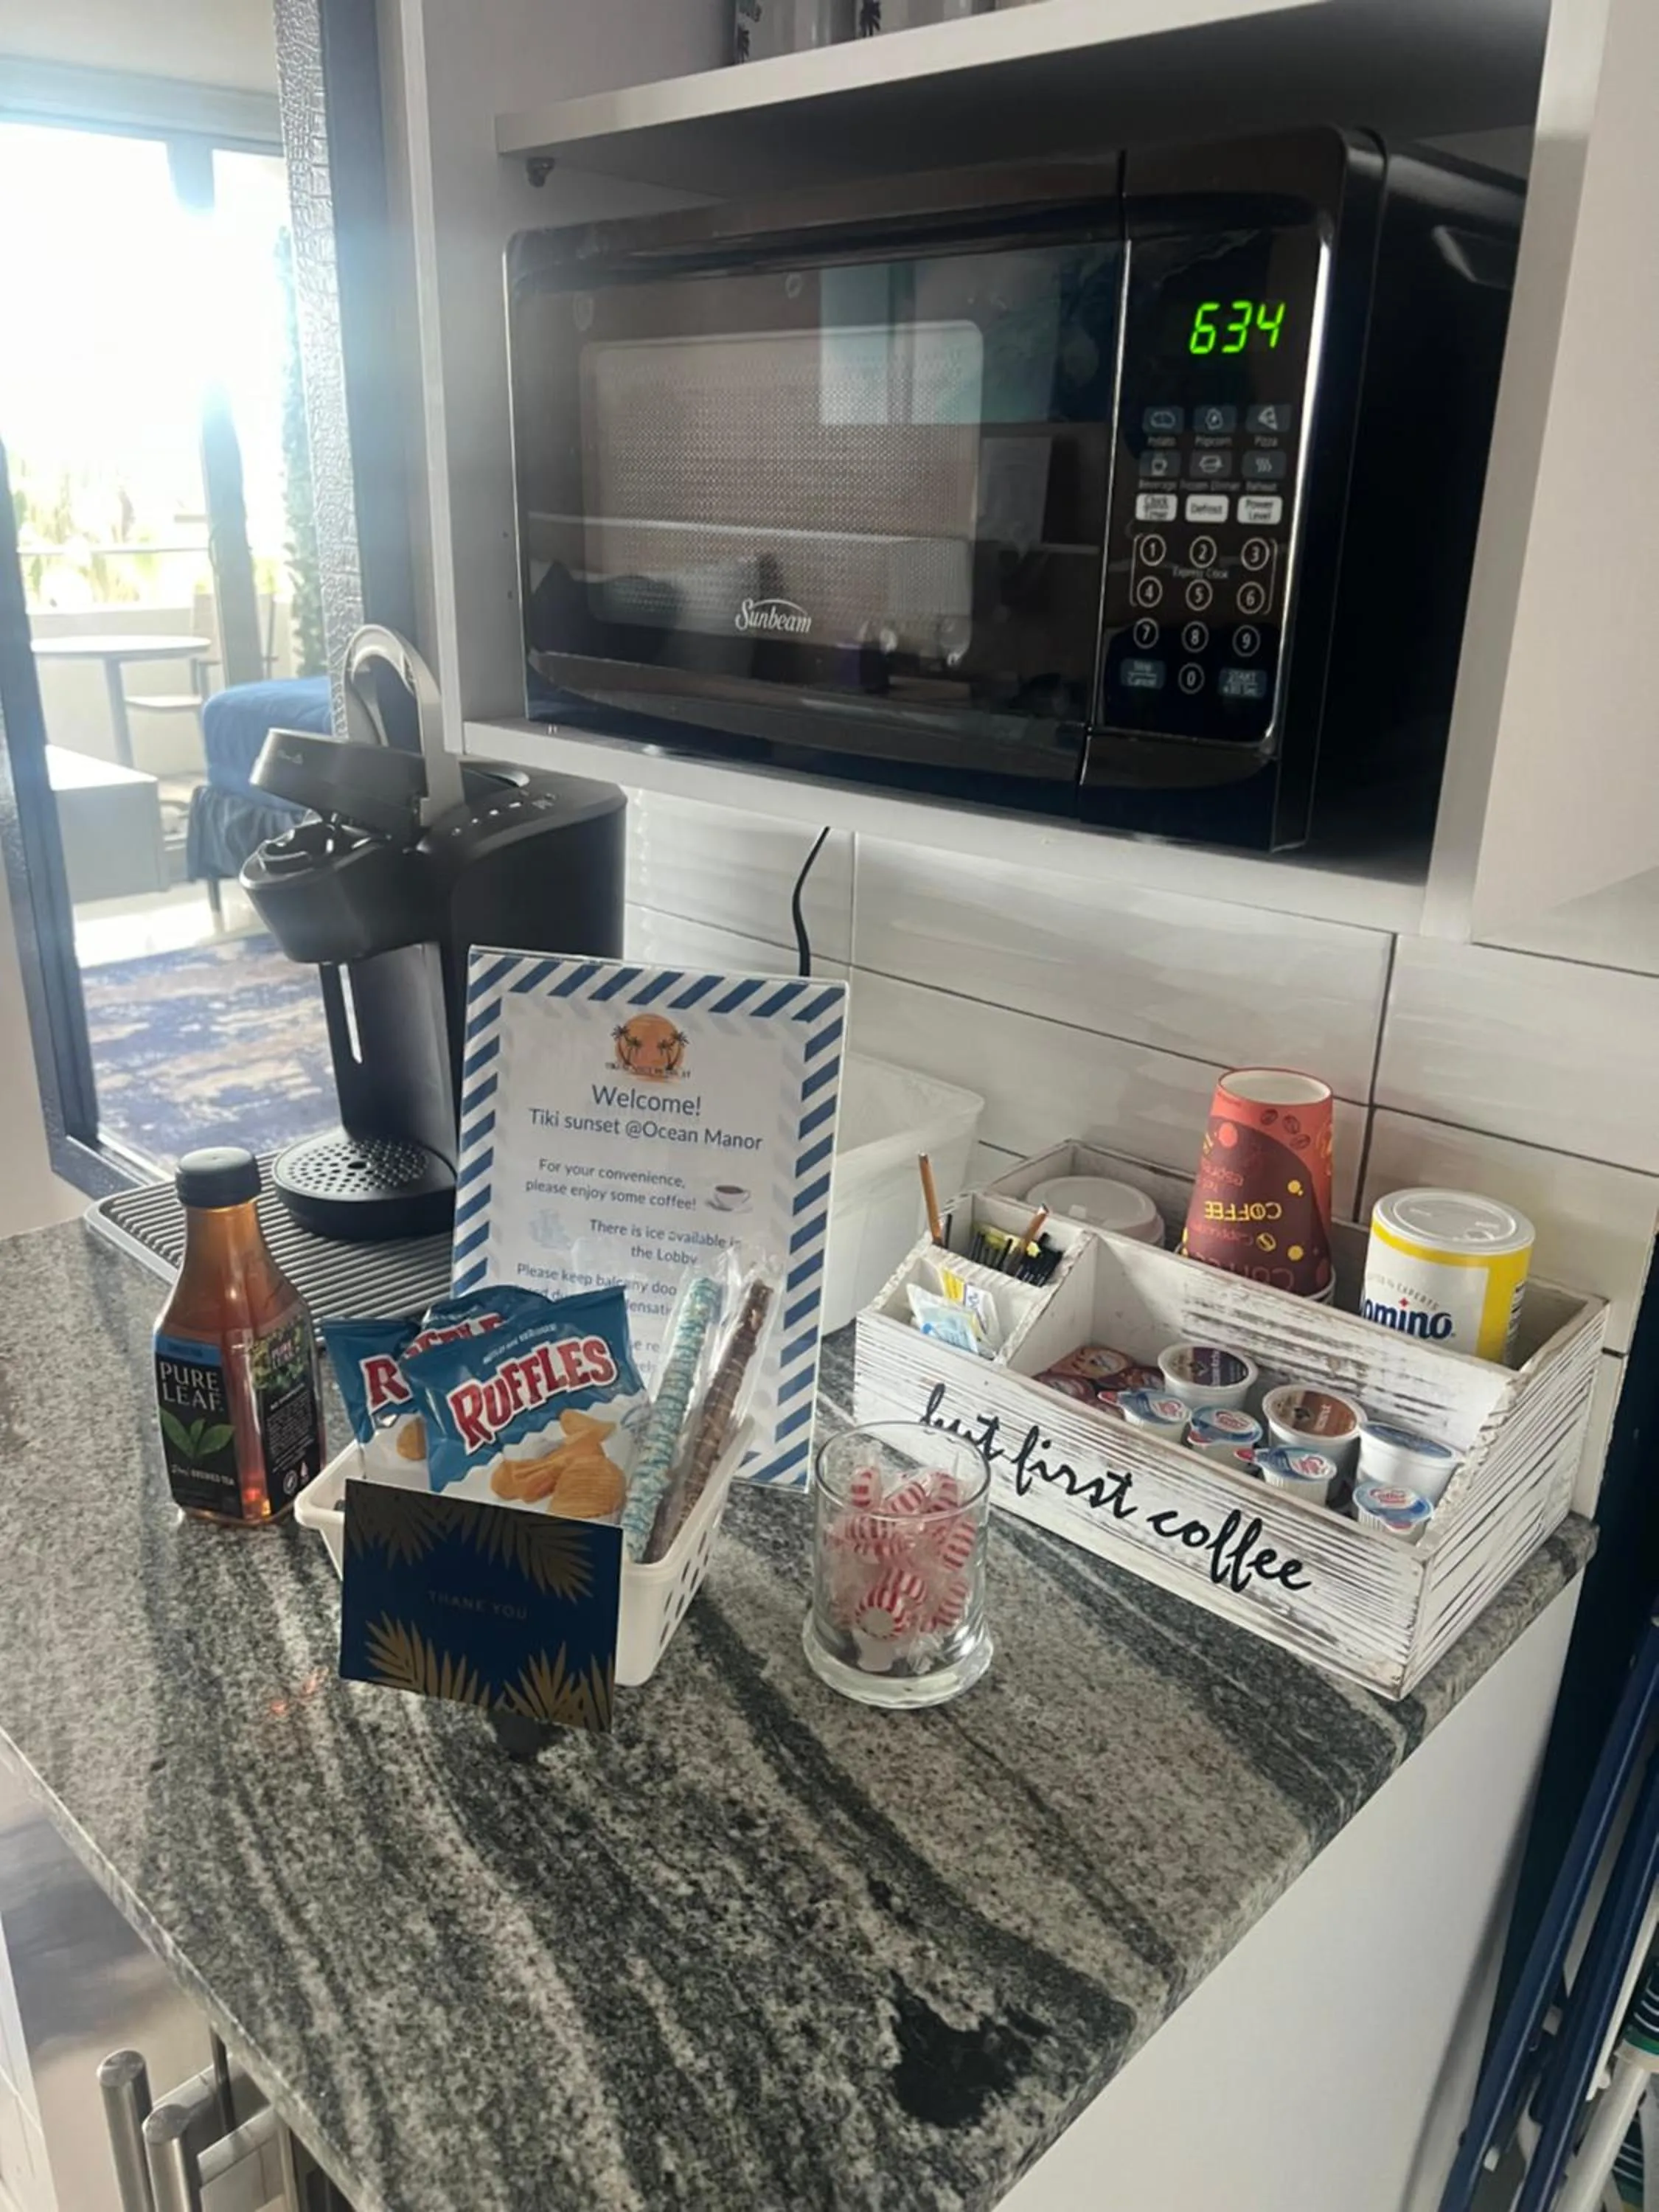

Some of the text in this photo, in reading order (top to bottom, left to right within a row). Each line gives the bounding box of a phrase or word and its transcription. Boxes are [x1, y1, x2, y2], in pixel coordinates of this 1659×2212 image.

[1189, 300, 1286, 355] 634
[1149, 542, 1157, 558] 1
[1198, 543, 1208, 561] 2
[1251, 546, 1260, 564] 3
[1144, 584, 1154, 600] 4
[1194, 586, 1203, 604] 5
[1246, 590, 1255, 607] 6
[735, 598, 812, 633] Sunbeam
[1143, 625, 1151, 642] 7
[1191, 629, 1200, 646] 8
[1242, 632, 1251, 650] 9
[1186, 670, 1196, 686] 0
[591, 1084, 701, 1117] Welcome!
[529, 1107, 763, 1150] Tiki sunset @Ocean Manor
[539, 1158, 562, 1172] For
[565, 1163, 595, 1177] your
[526, 1179, 697, 1211] please enjoy some coffee!
[1203, 1200, 1283, 1222] COFFEE
[590, 1218, 627, 1237] There
[630, 1223, 642, 1238] is
[645, 1225, 665, 1241] ice
[667, 1231, 728, 1249] available
[631, 1245, 699, 1266] the Lobby
[517, 1262, 560, 1281] Please
[561, 1268, 593, 1287] keep
[651, 1281, 678, 1297] doo
[159, 1361, 220, 1392] PURE
[162, 1381, 222, 1411] LEAF
[447, 1335, 616, 1455] RUFFLES
[1011, 1425, 1138, 1519] first
[1146, 1509, 1312, 1593] coffee
[427, 1589, 529, 1621] THANK YOU
